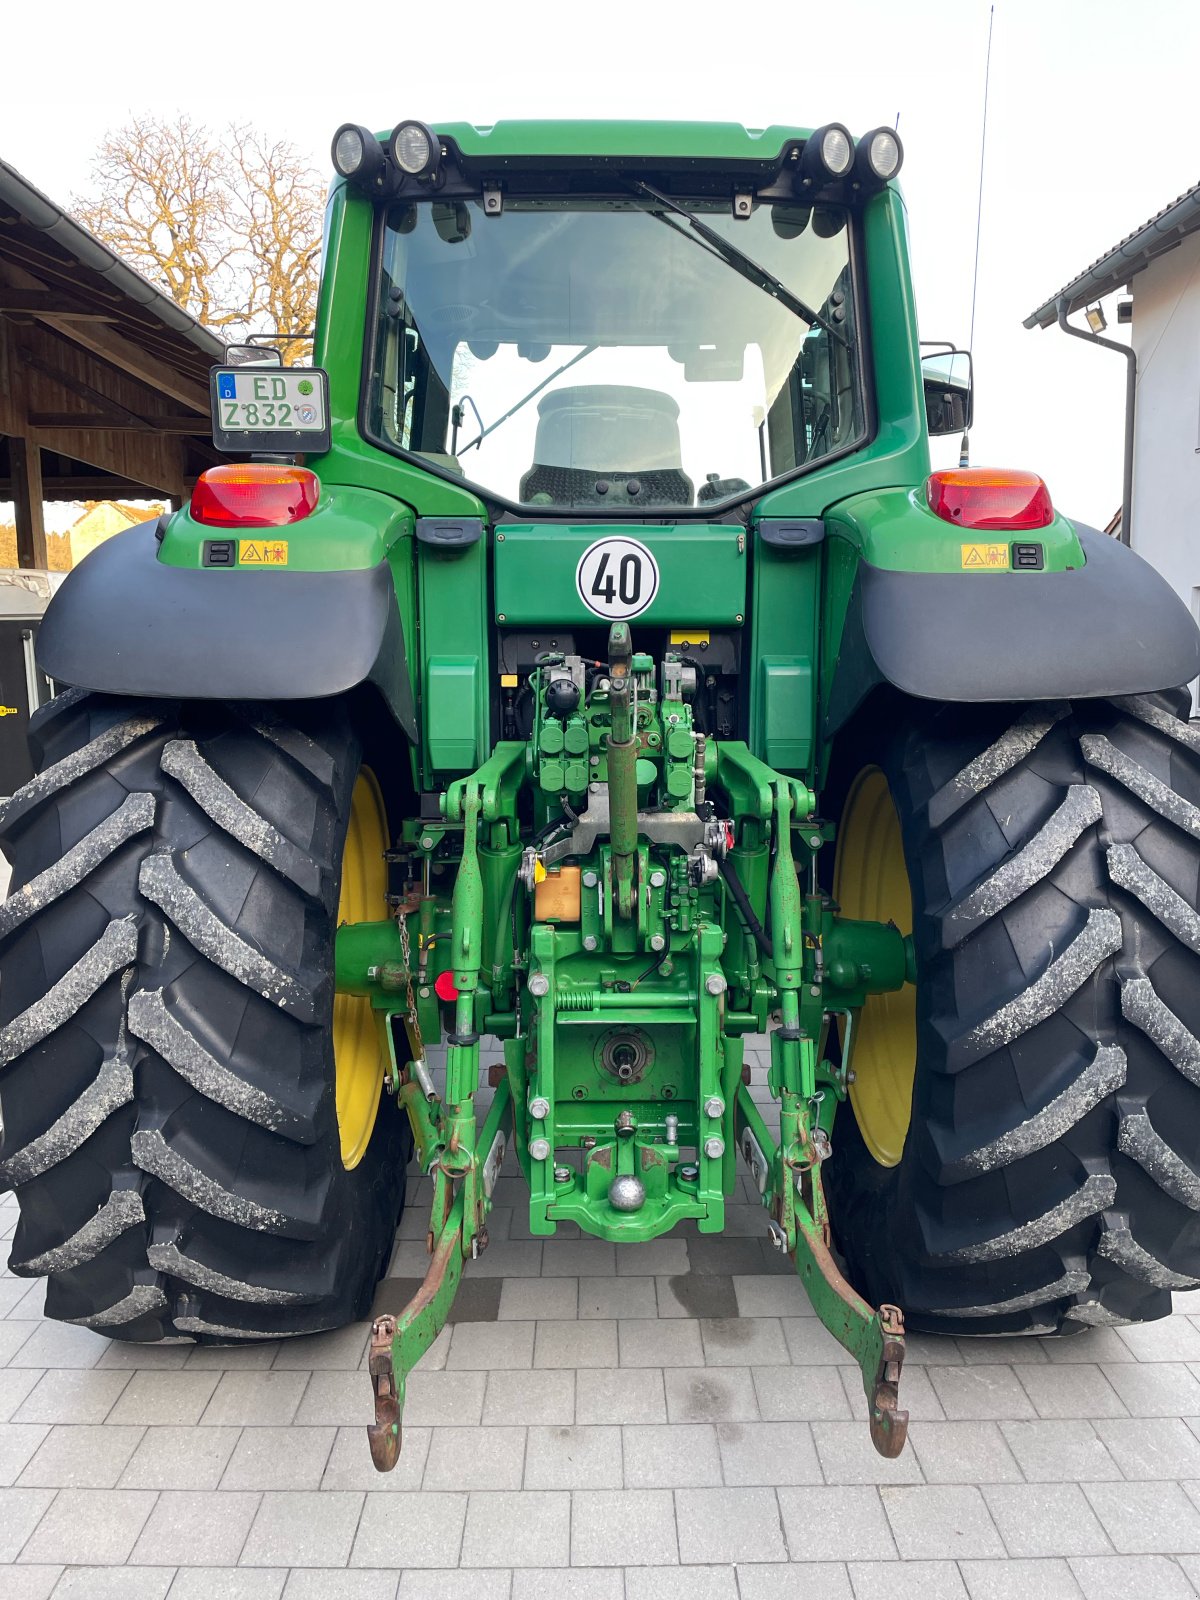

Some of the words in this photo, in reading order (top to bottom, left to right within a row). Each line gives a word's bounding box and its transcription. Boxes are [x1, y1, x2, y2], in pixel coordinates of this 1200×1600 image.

[224, 389, 232, 398] D
[253, 377, 287, 401] ED
[245, 403, 293, 427] 832
[591, 553, 642, 605] 40
